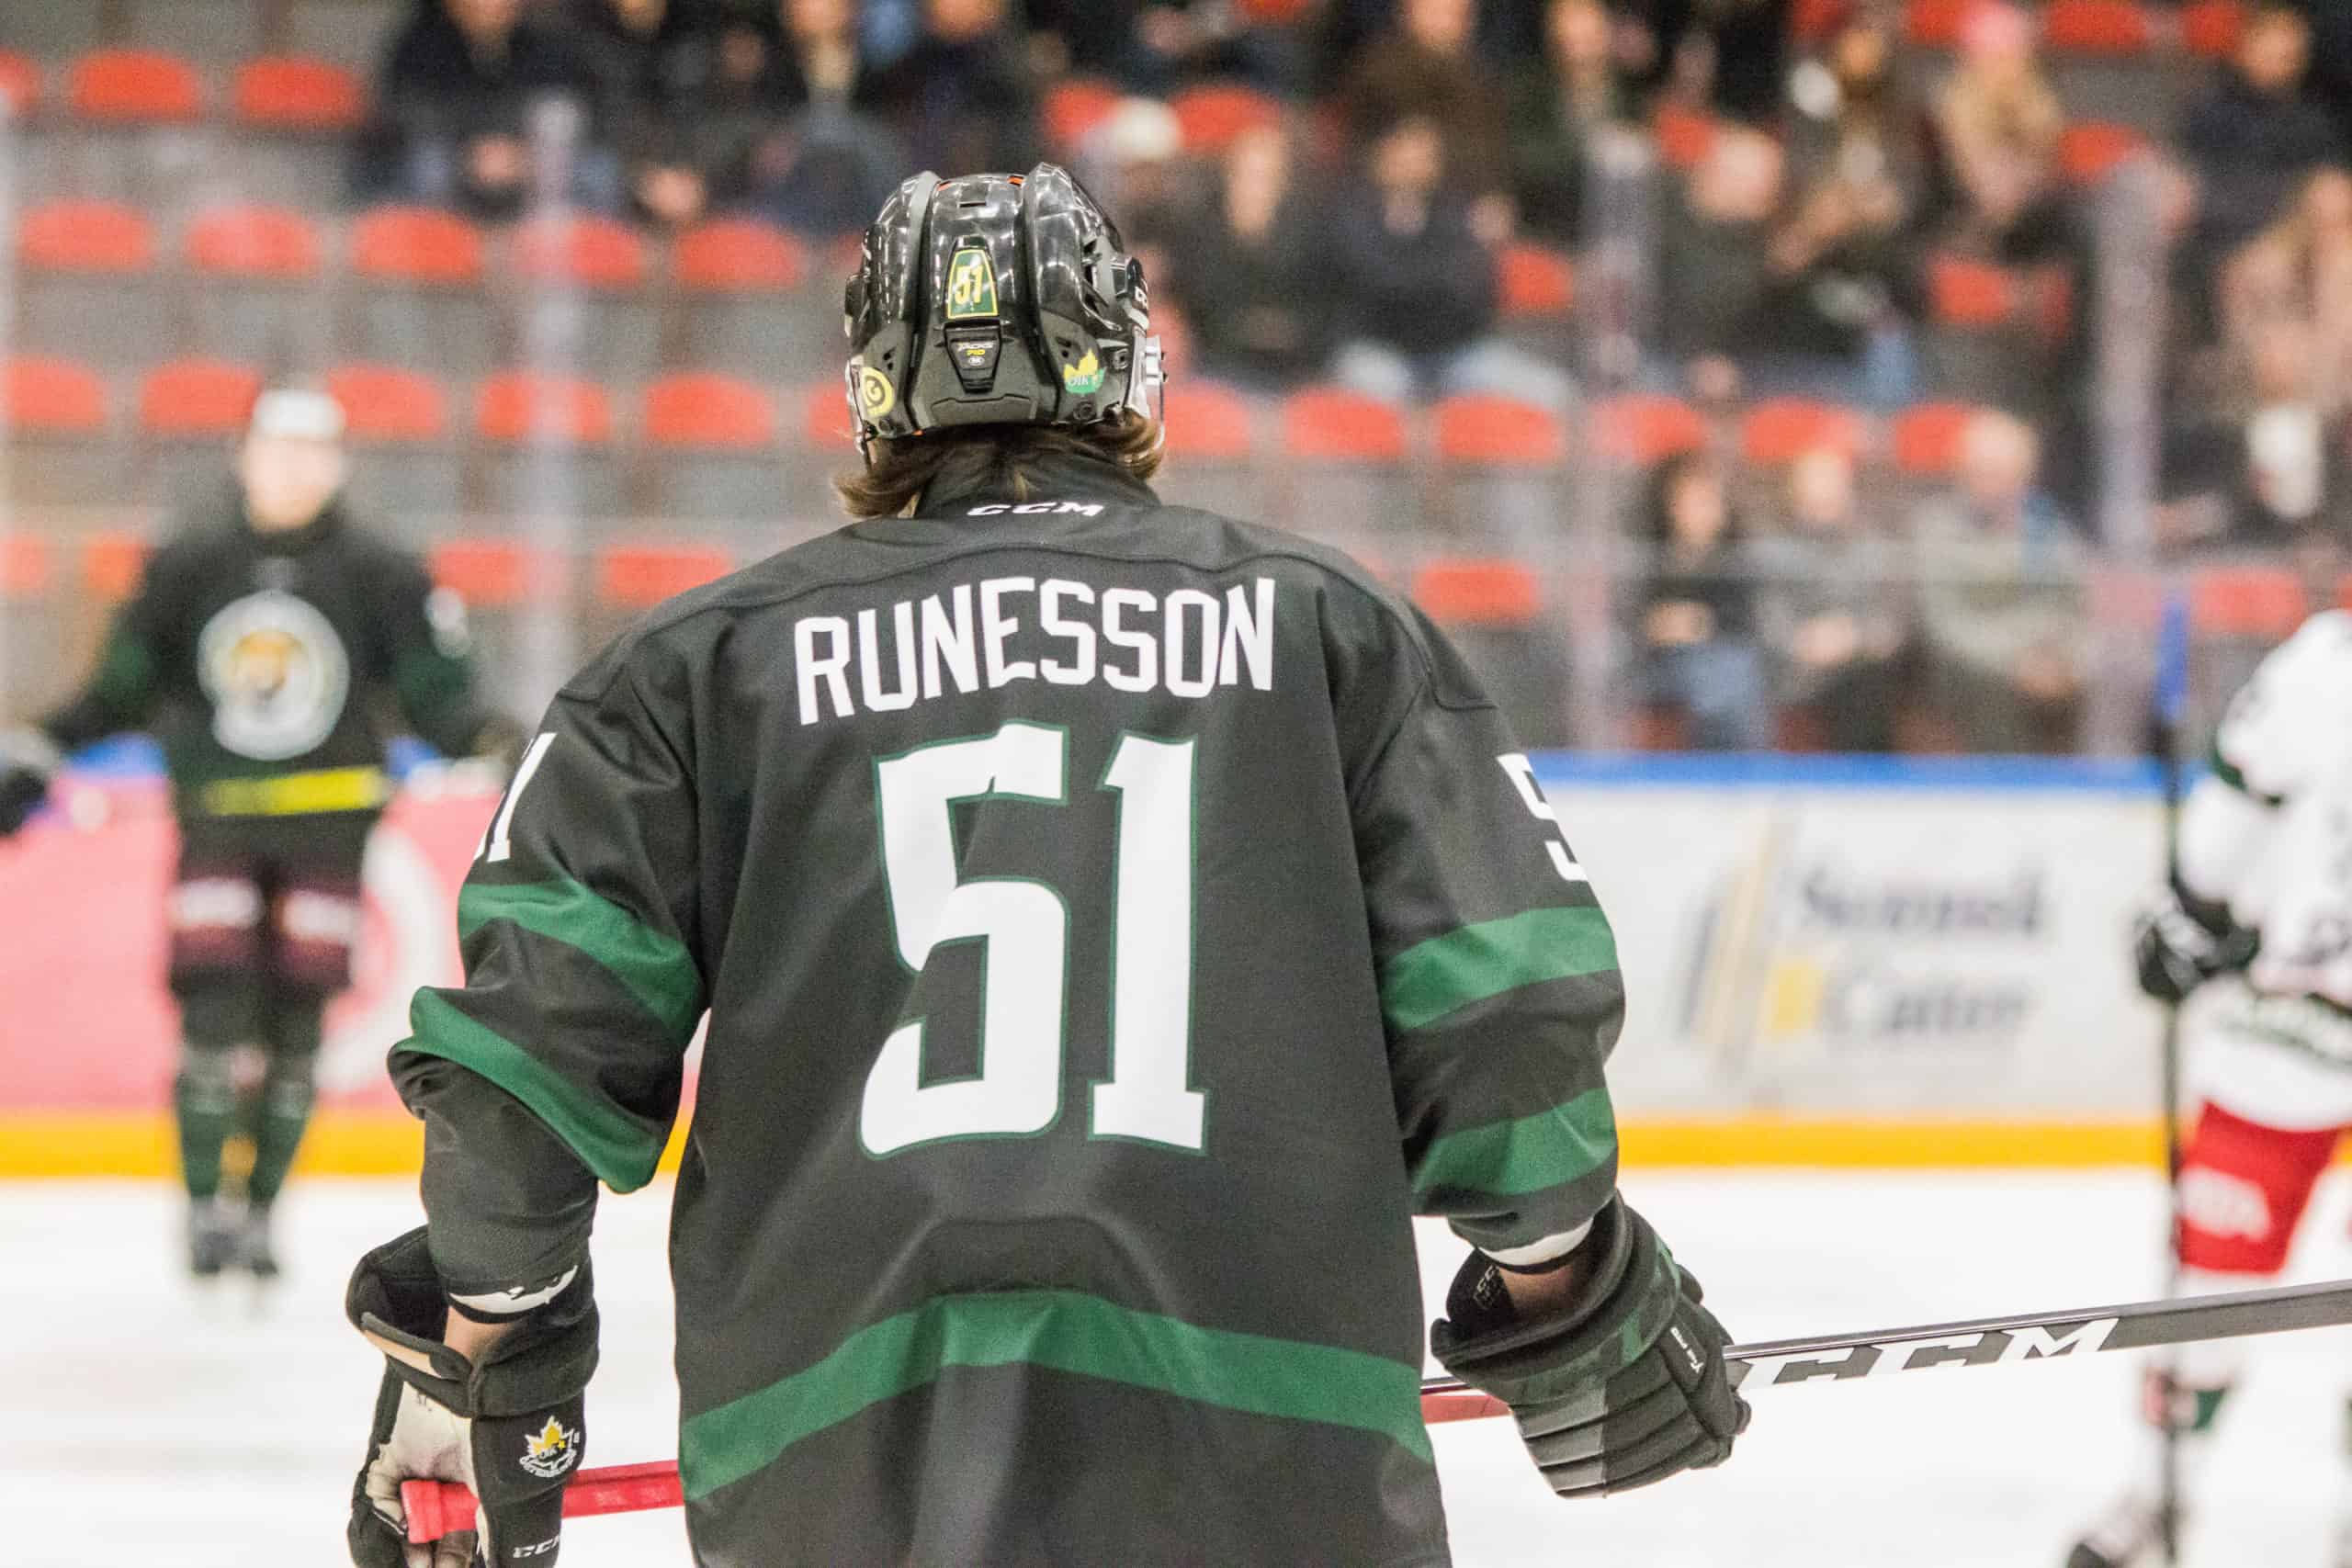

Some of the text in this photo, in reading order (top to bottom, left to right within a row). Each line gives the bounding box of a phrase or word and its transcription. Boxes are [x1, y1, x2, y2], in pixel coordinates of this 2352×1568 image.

[955, 265, 983, 304] 51
[967, 502, 1104, 516] CCM
[794, 576, 1275, 725] RUNESSON
[860, 719, 1210, 1160] 51
[1737, 1316, 2119, 1392] CCM
[513, 1535, 560, 1559] CC
